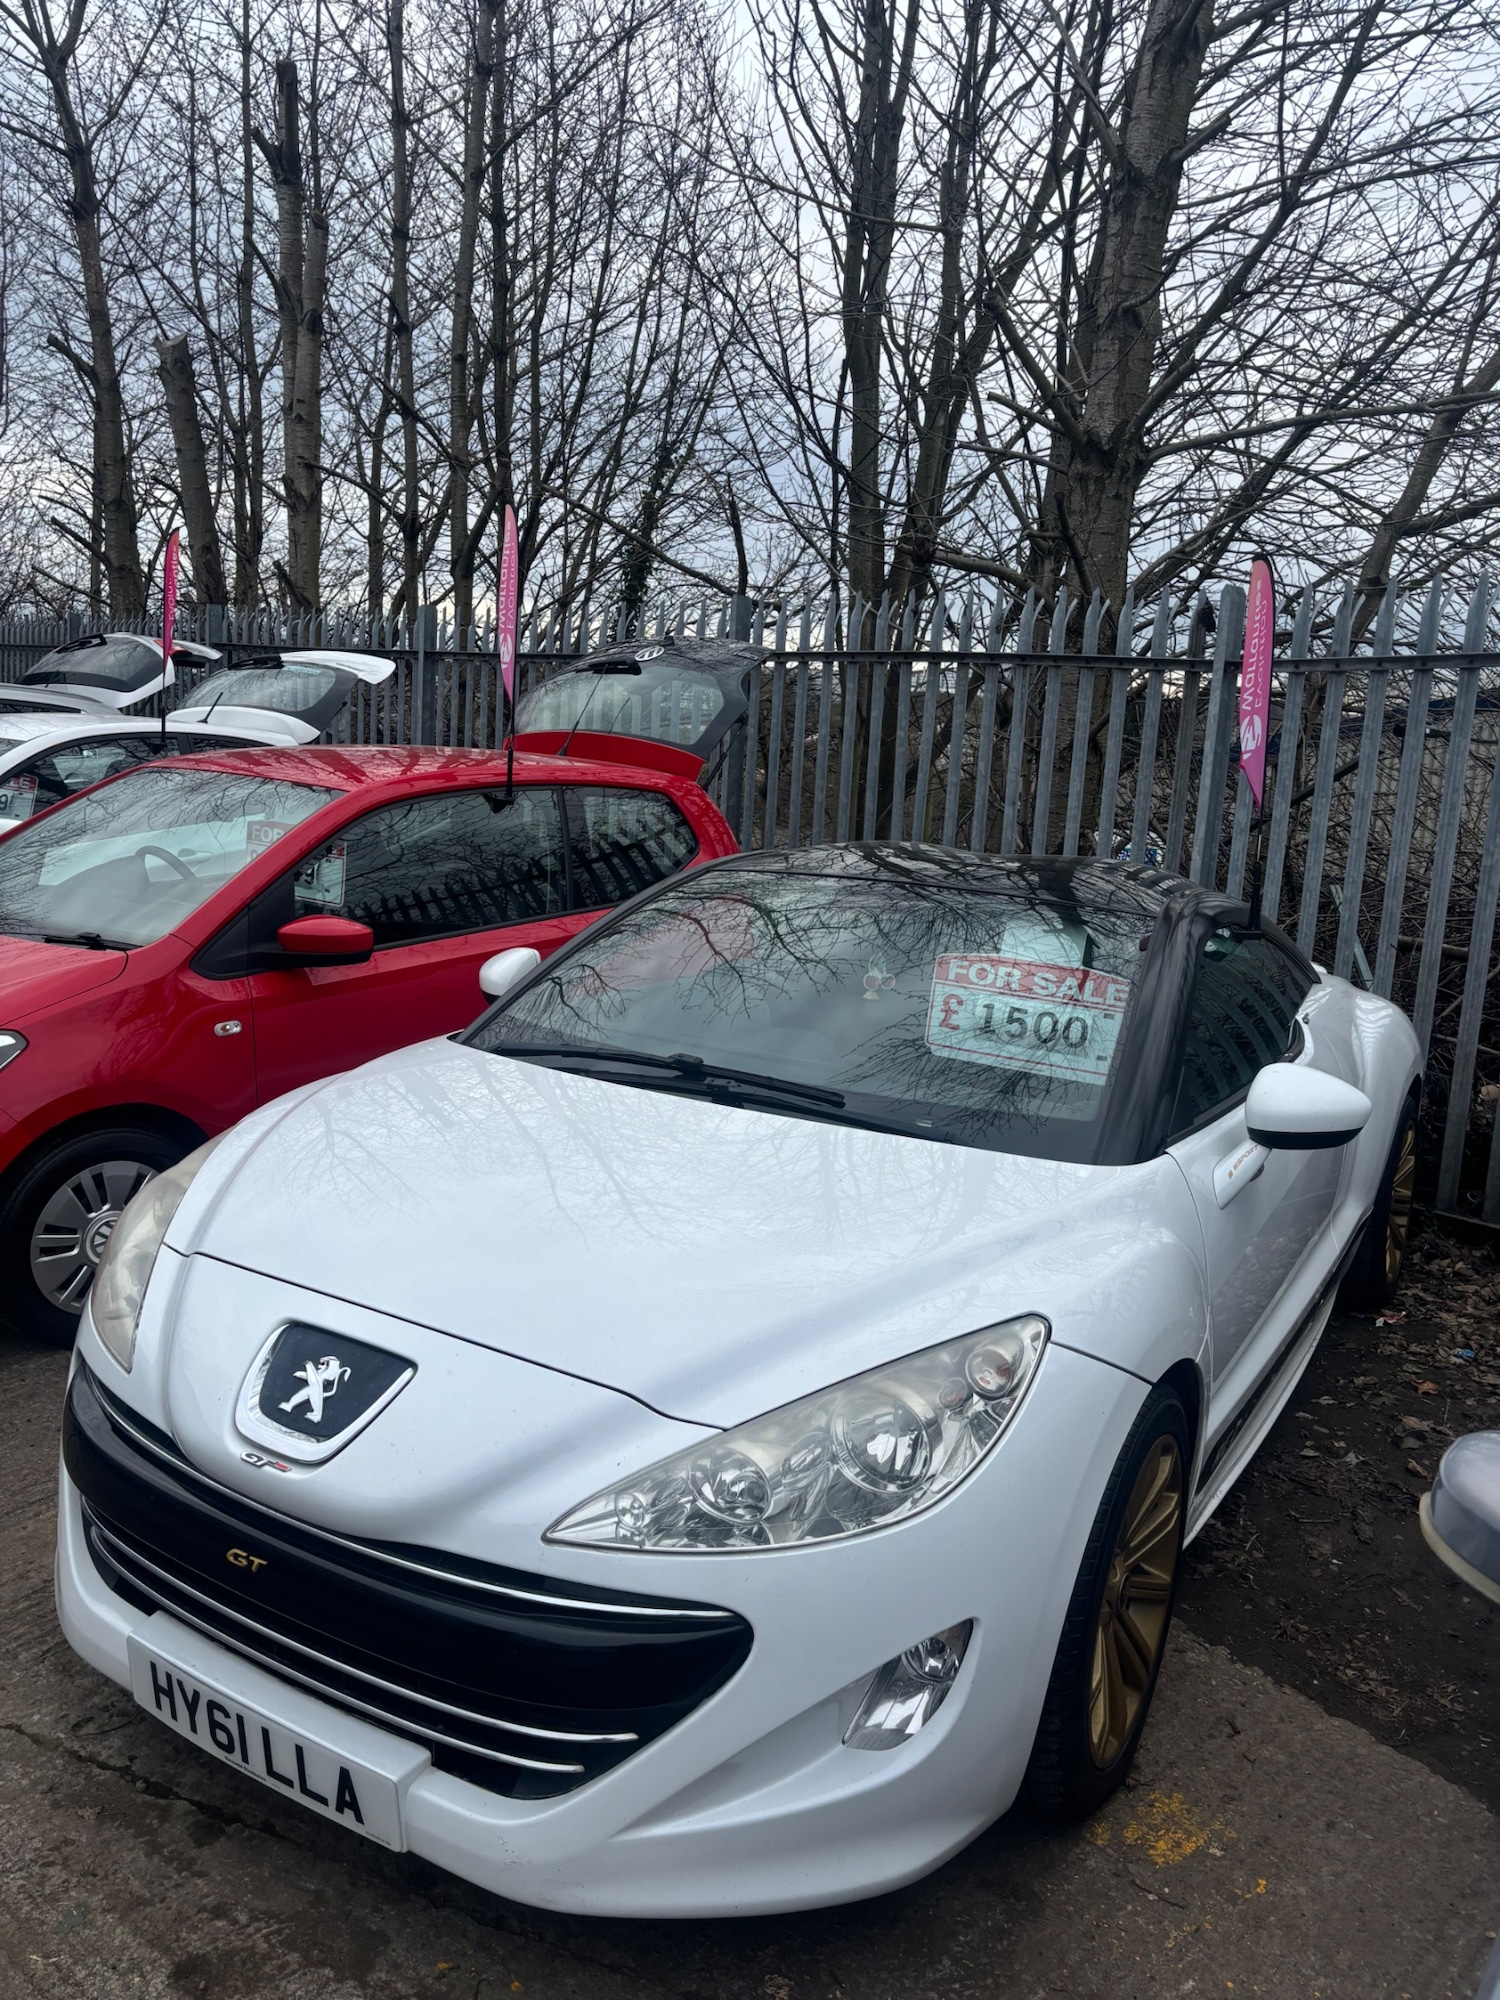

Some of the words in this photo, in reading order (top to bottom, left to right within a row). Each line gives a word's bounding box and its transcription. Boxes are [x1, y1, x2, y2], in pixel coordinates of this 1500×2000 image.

[947, 959, 1021, 991] FOR
[1032, 972, 1131, 1004] SALE
[979, 1002, 1089, 1049] 1500
[226, 1548, 268, 1573] GT
[150, 1661, 249, 1766] HY61
[261, 1725, 365, 1826] LLA
